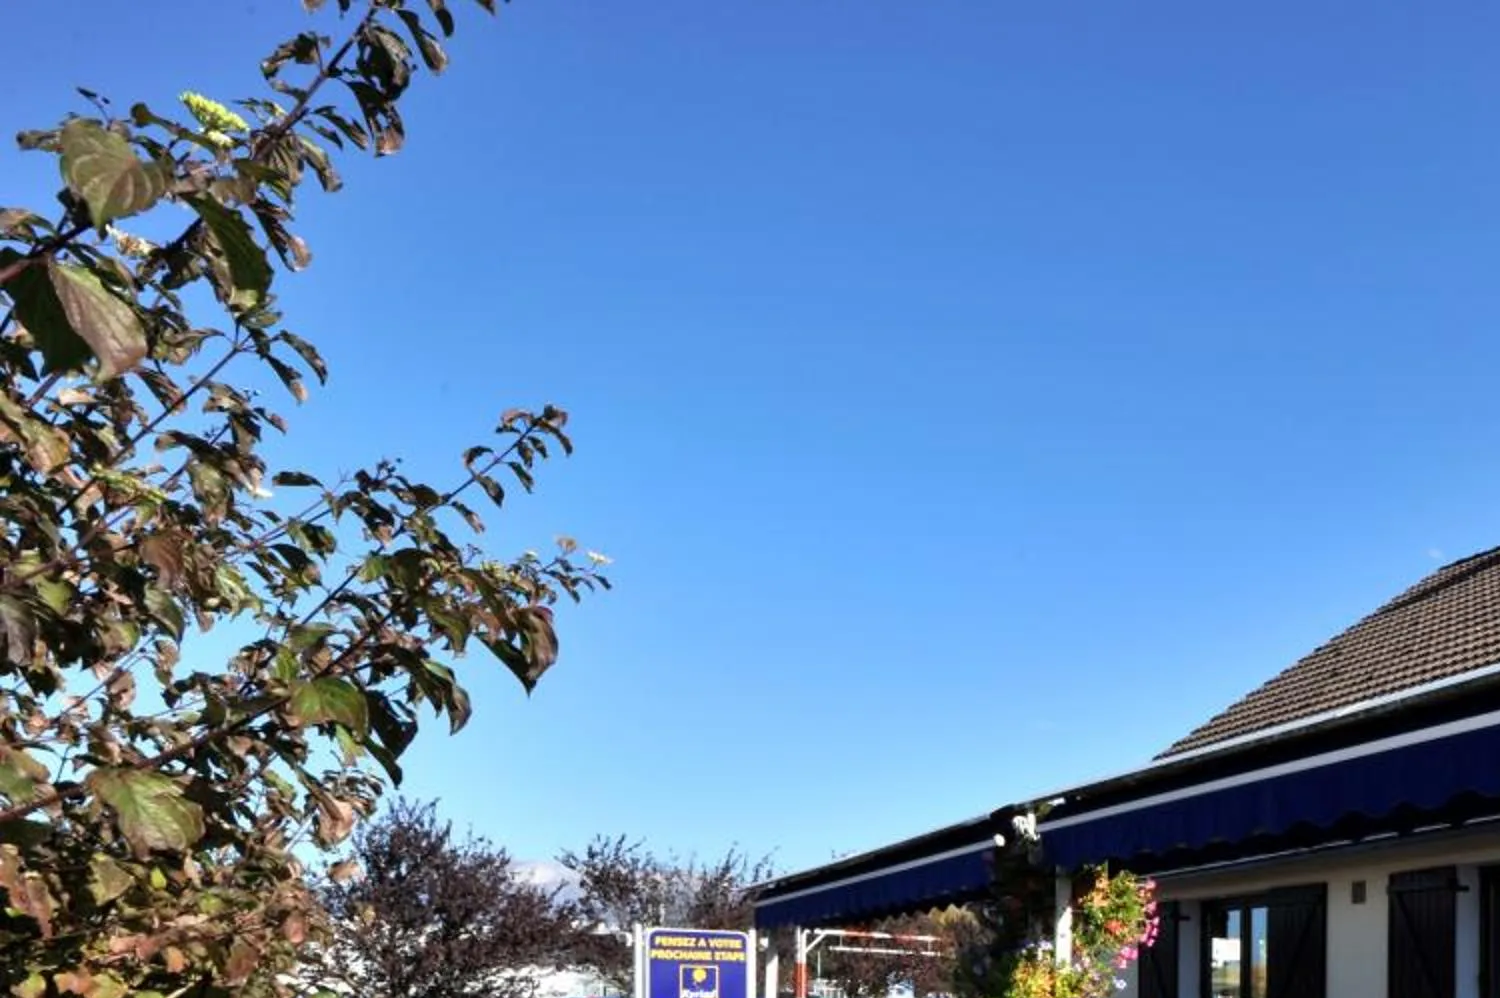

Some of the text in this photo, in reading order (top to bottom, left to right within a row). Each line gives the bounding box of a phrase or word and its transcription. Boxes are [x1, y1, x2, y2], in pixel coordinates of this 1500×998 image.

[655, 936, 743, 949] PENSEZ A VOTRE
[651, 950, 712, 961] PROCHAINE
